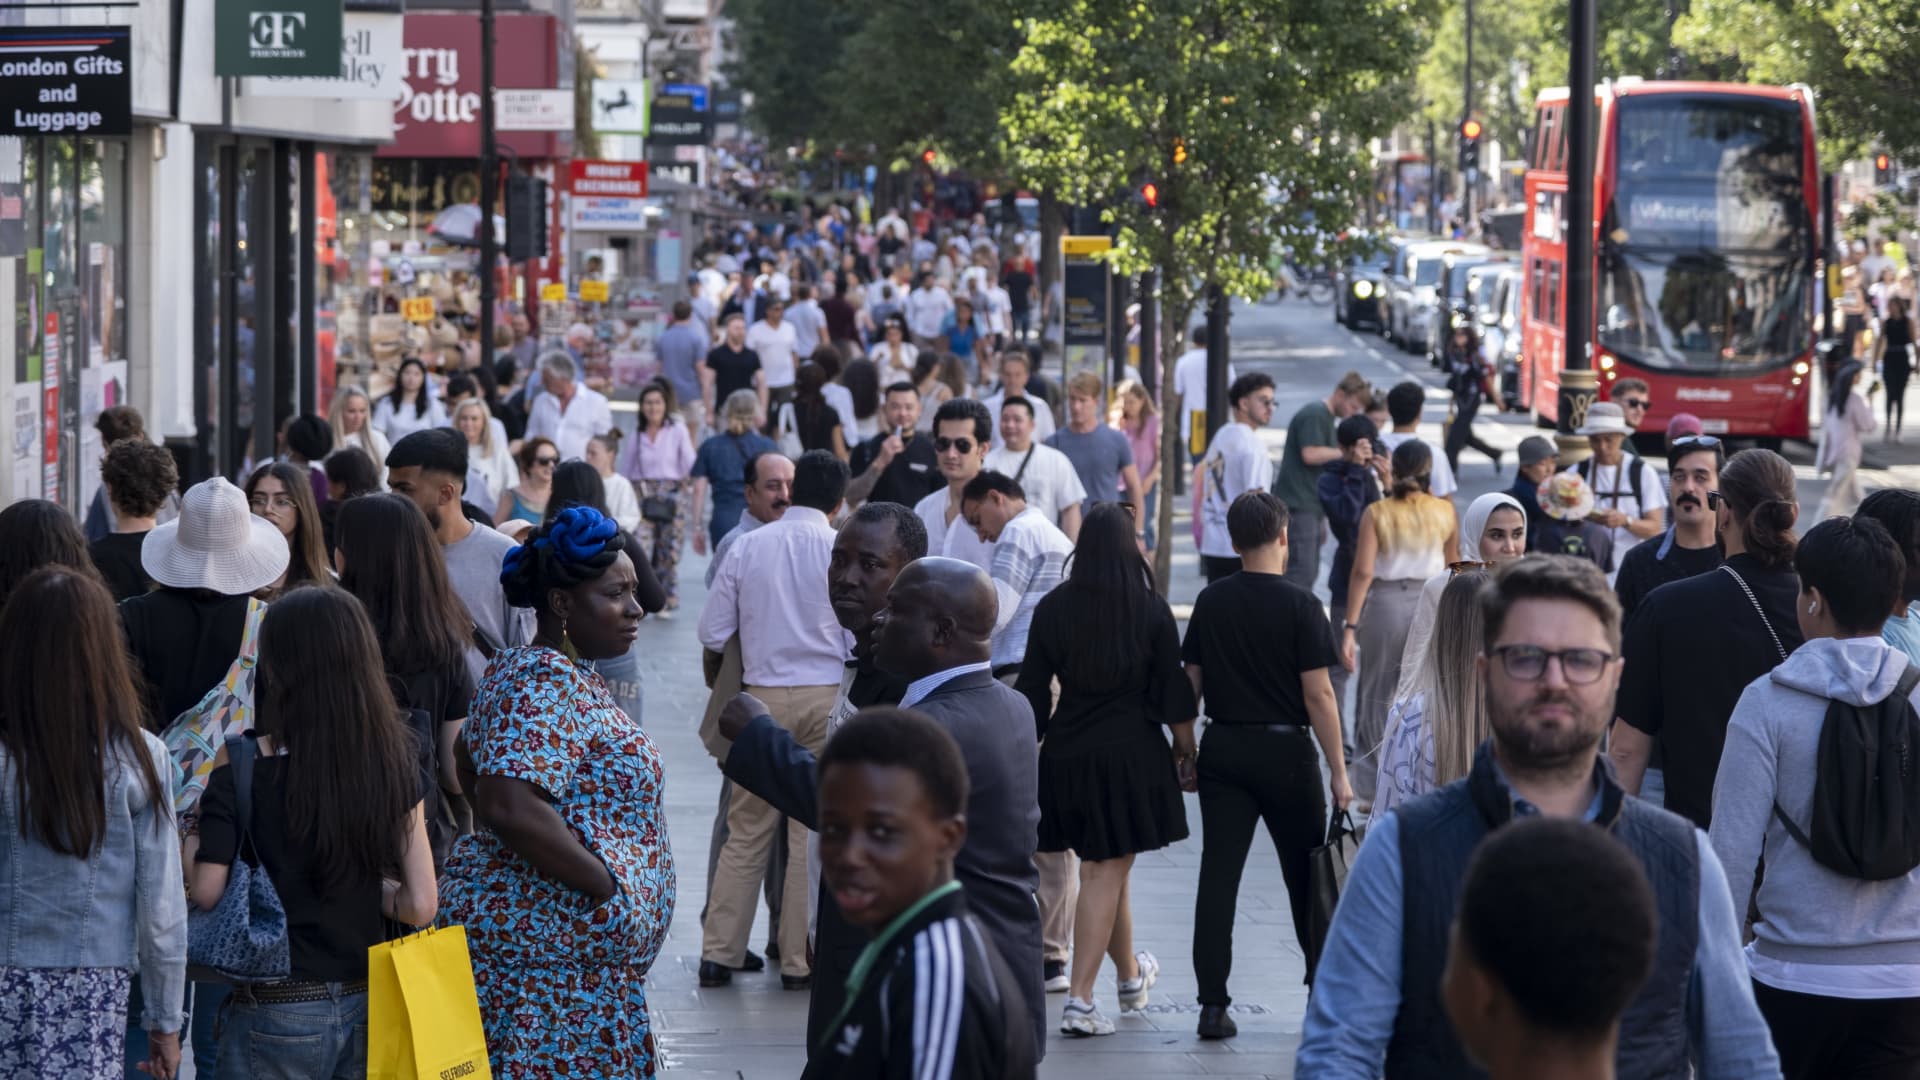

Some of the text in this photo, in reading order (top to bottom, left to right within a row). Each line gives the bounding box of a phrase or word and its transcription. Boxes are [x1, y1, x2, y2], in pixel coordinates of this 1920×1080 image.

[0, 55, 123, 76] ondon Gifts
[400, 47, 460, 86] rry
[38, 82, 77, 102] and
[393, 80, 482, 132] Potte
[15, 108, 102, 132] Luggage
[585, 164, 632, 178] MONEY
[574, 179, 642, 194] EXCHANGE
